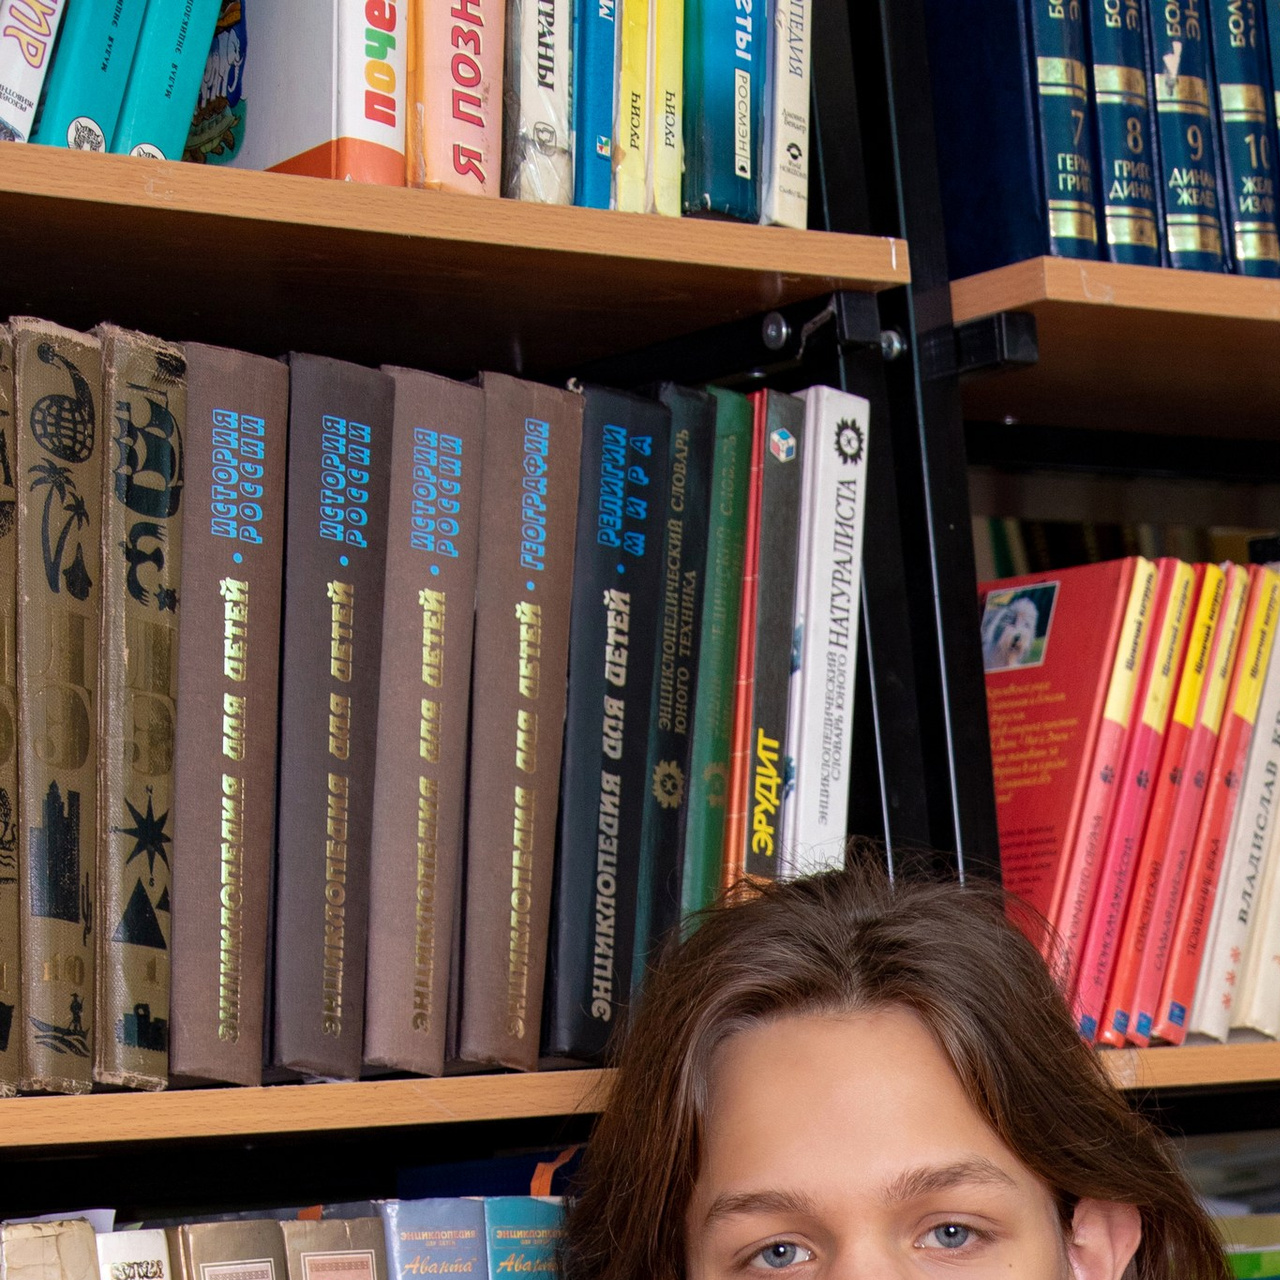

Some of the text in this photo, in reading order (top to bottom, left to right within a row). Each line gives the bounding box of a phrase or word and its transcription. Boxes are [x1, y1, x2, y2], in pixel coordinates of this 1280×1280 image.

[101, 35, 115, 72] МАЛАЯ
[164, 62, 181, 99] МАЛАЯ
[736, 73, 750, 156] РОСМЭН
[451, 143, 484, 183] Я
[629, 91, 642, 150] РУСИЧ
[663, 90, 677, 149] РУСИЧ
[1071, 108, 1085, 147] 7
[1126, 117, 1144, 155] 8
[1186, 125, 1204, 162] 9
[211, 409, 238, 538] ИСТОРИЯ
[239, 415, 266, 543] РОССИИ
[319, 415, 346, 541] ИСТОРИЯ
[347, 422, 372, 547] РОССИИ
[409, 428, 437, 551] ИСТОРИЯ
[437, 434, 462, 557] РОССИИ
[520, 417, 550, 571] ГЕОГРАФИЯ
[597, 424, 626, 547] РЕЛИГИИ
[622, 435, 650, 556] МИРА
[658, 429, 690, 731] ЭНЦИКЛОПЕДИЧЕСКИЙ СЛОВАРЬ
[828, 478, 857, 650] НАТУРАЛИСТА
[673, 569, 697, 734] ЮНОГО ТЕХНИКА
[818, 650, 835, 826] ЭНЦИКЛОПЕДИЧЕСКИЙ
[830, 654, 848, 782] СЛОВАРЬ ЮНОГО
[218, 578, 249, 1042] ЭНЦИКЛОПЕДИЯ ДЛЯ ДЕТЕЙ
[321, 581, 354, 1037] ЭНЦИКЛОПЕДИЯ ДЛЯ ДЕТЕЙ
[410, 588, 446, 1033] ЭНЦИКЛОПЕДИЯ ДЛЯ ДЕТЕЙ
[504, 602, 542, 1039] ЭНЦИКЛОПЕДИЯ ДЛЯ ДЕТЕЙ
[589, 588, 631, 1022] ЭНЦИКЛОПЕДИЯ ДЛЯ ДЕТЕЙ
[751, 727, 782, 856] ЭРУДИТ
[1236, 760, 1278, 926] ВЛАДИСЛАВ
